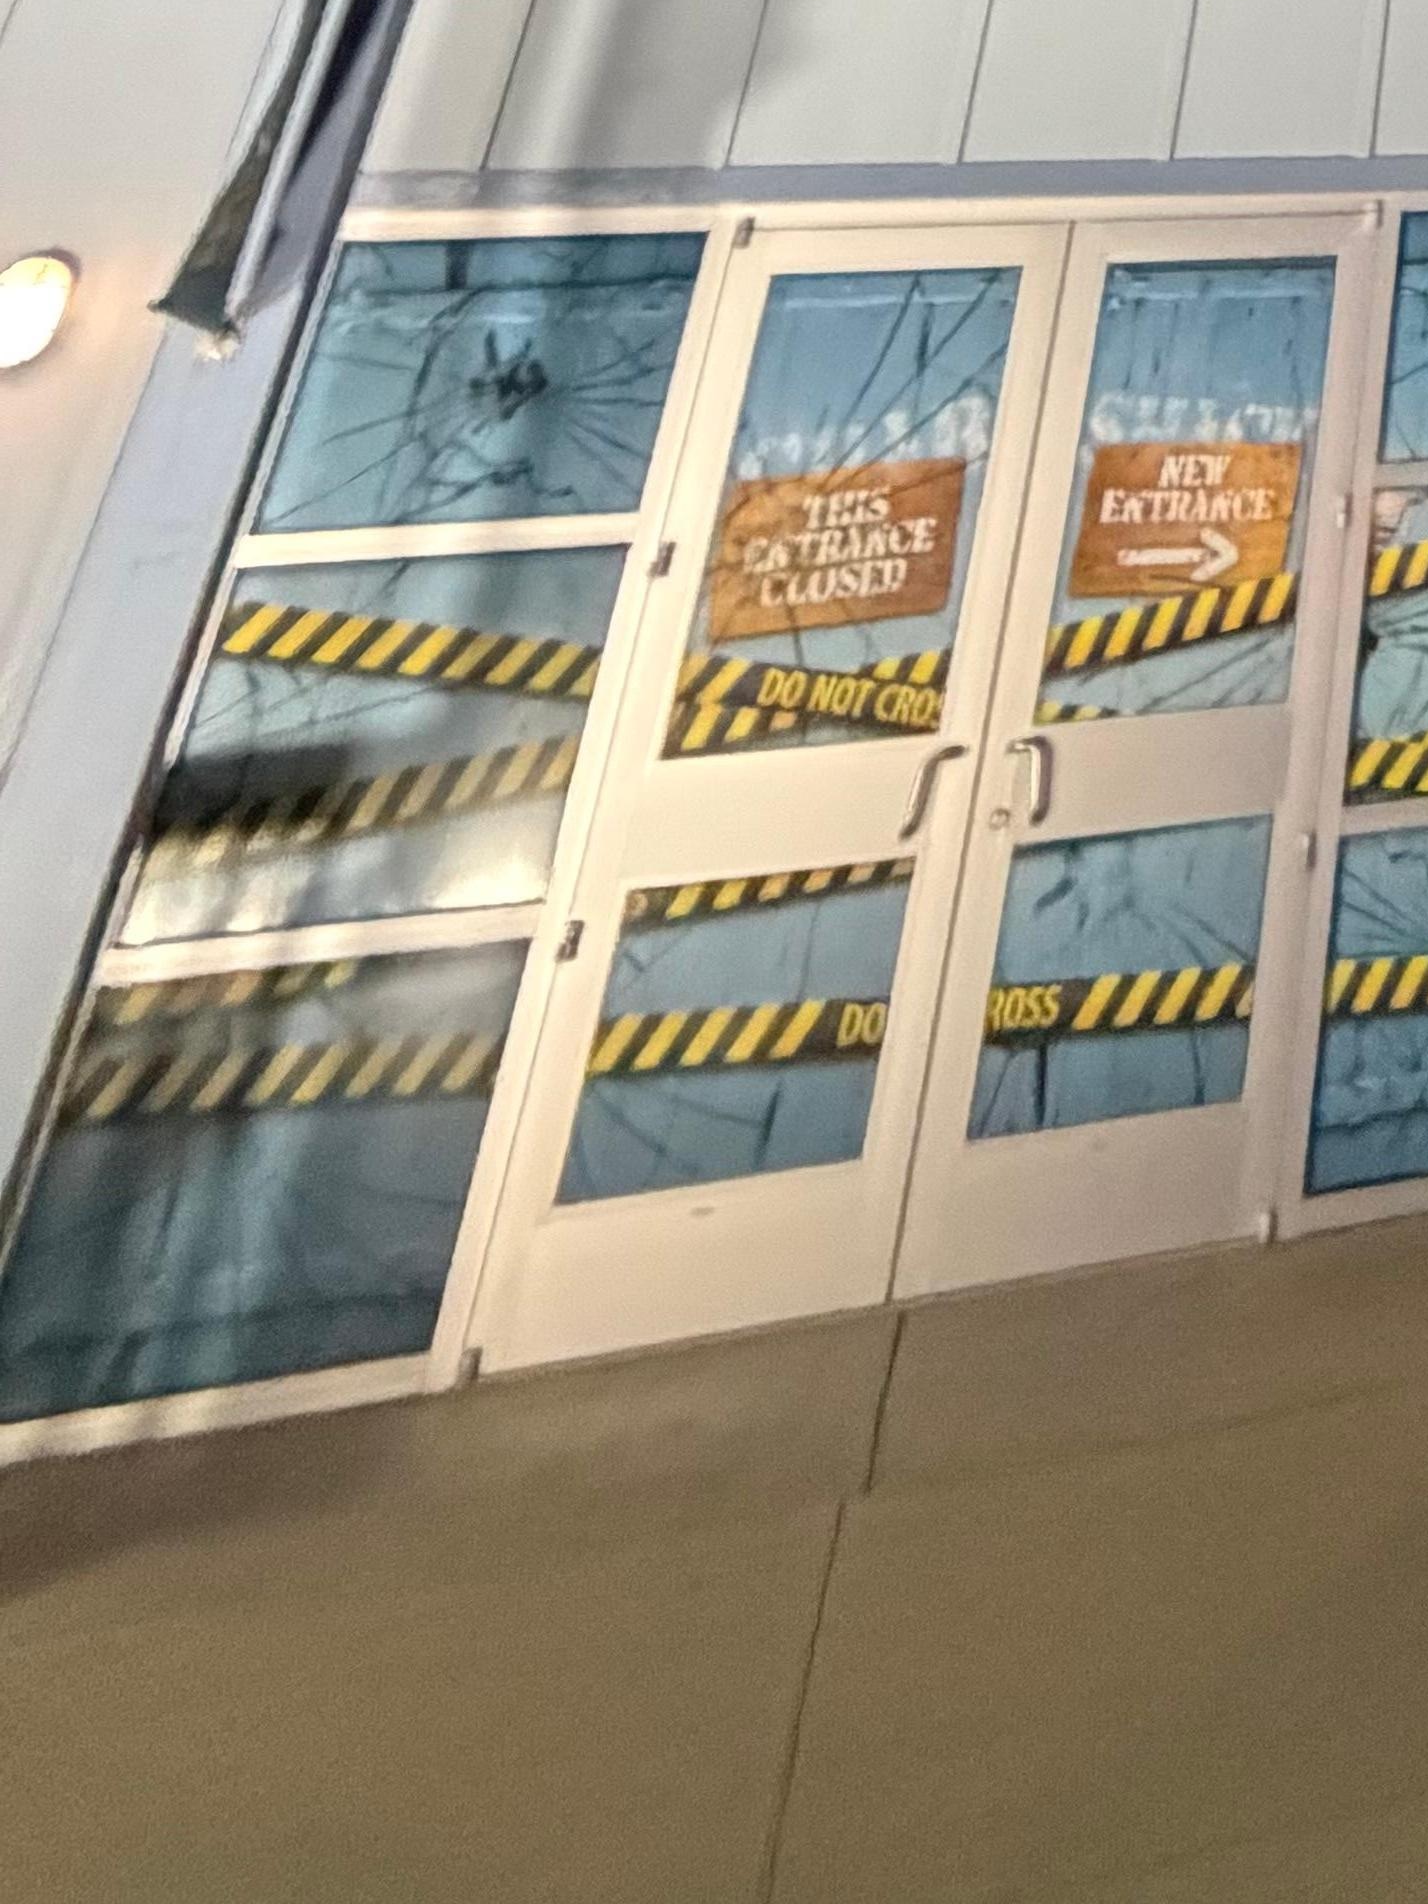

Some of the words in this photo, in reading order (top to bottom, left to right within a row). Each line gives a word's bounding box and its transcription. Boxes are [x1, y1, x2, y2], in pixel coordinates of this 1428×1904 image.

[1158, 454, 1232, 489] NEW
[803, 488, 892, 530] THIS
[1099, 487, 1276, 524] ENTRANCE
[741, 516, 938, 575] ENTRANCE
[758, 556, 909, 608] CLOSED
[757, 667, 808, 708] DO
[806, 673, 875, 718] NOT
[873, 683, 946, 729] CRO
[836, 1002, 889, 1049] DO
[983, 984, 1063, 1034] ROSS
